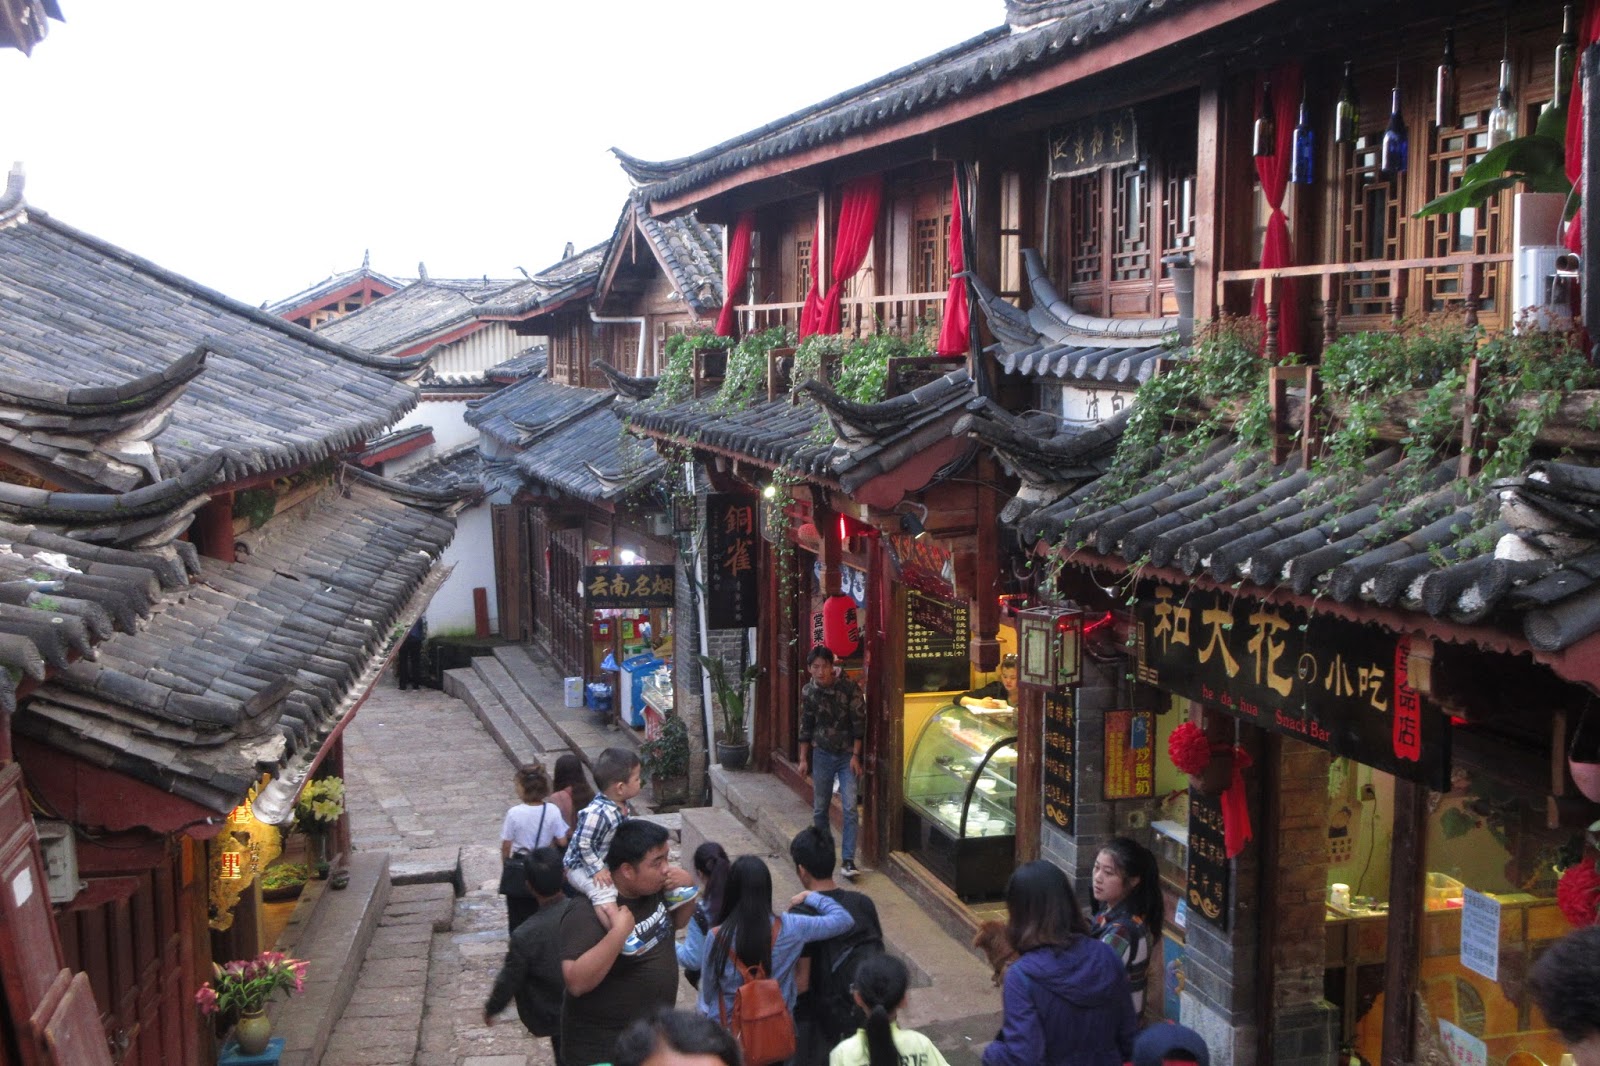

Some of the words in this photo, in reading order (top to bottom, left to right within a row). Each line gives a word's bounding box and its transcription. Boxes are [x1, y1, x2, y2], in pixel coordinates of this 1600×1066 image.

[723, 505, 753, 578] 銅雀
[588, 573, 673, 597] 云南名烟
[1202, 683, 1214, 700] he
[1221, 690, 1233, 707] da
[1240, 697, 1259, 717] hua
[1275, 708, 1308, 735] Snack
[1310, 721, 1331, 742] Bar
